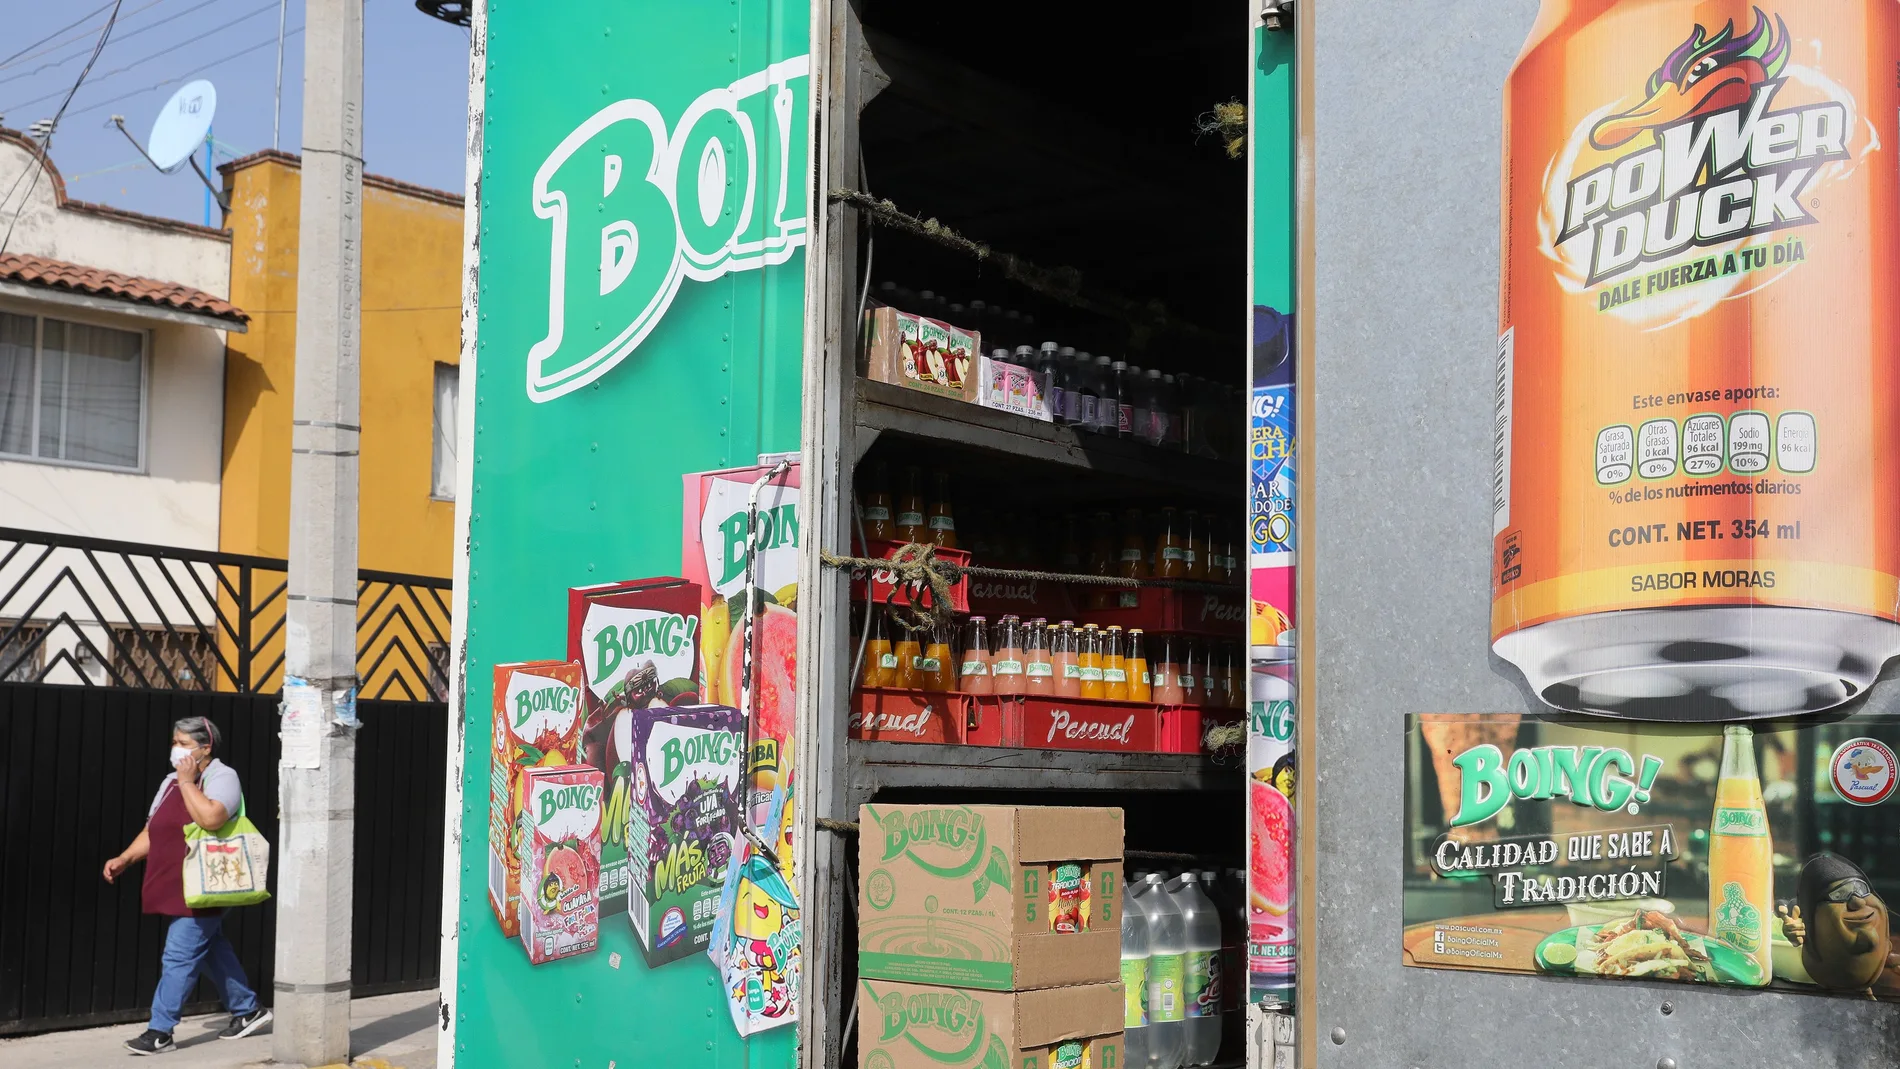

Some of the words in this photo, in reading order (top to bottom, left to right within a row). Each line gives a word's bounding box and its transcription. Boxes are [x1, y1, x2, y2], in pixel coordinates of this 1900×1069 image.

[526, 54, 809, 403] BOI
[1586, 166, 1814, 282] DUCK
[1600, 278, 1641, 311] DALE
[1647, 259, 1717, 296] FUERZA
[1723, 254, 1737, 275] A
[1742, 247, 1767, 271] TU
[1773, 238, 1805, 264] DÍA
[1632, 394, 1663, 410] Este
[1666, 390, 1721, 405] envase
[1724, 385, 1780, 404] aporta:
[1650, 424, 1668, 436] Otras
[1687, 419, 1720, 431] Azúcares
[1739, 427, 1760, 439] Sodio
[1605, 430, 1625, 442] Grasa
[1645, 435, 1670, 447] Grasas
[1690, 431, 1717, 442] Totales
[1600, 441, 1630, 454] Saturada
[1645, 449, 1650, 457] 0
[1652, 447, 1670, 457] kcal
[1687, 444, 1699, 453] 96
[1701, 442, 1719, 452] kcal
[1781, 444, 1792, 453] 96
[1794, 443, 1811, 453] kcal
[1602, 455, 1608, 463] 0
[1611, 453, 1627, 463] kcal
[1690, 460, 1716, 470] 27%
[1735, 458, 1759, 468] 10%
[1606, 469, 1623, 479] 0%
[1649, 464, 1667, 473] 0%
[1609, 491, 1623, 504] %
[1624, 487, 1641, 503] de
[1644, 486, 1663, 500] los
[1665, 480, 1753, 498] nutrimentos
[1755, 479, 1801, 495] diarios
[1251, 499, 1273, 514] DO
[1274, 498, 1292, 512] DE
[1608, 523, 1669, 548] CONT.
[1677, 520, 1724, 541] NET.
[1731, 519, 1770, 540] 354
[1777, 521, 1800, 540] ml
[967, 574, 1038, 605] ascual
[1631, 571, 1697, 592] SABOR
[1702, 570, 1776, 588] MORAS
[592, 614, 698, 686] BOING!
[998, 660, 1020, 671] BOING!
[1029, 662, 1051, 672] BOING!
[514, 686, 579, 729] BOING!
[850, 704, 932, 737] ascual
[1047, 709, 1135, 744] Pascual
[659, 731, 742, 788] BOING!
[750, 744, 774, 763] ABA
[1450, 744, 1664, 828] BOING!
[1849, 780, 1879, 791] Pascual
[538, 785, 603, 827] BOING!
[700, 793, 718, 814] UVA
[881, 810, 984, 862] BOING!
[1435, 840, 1559, 871] CALIDAD
[1568, 834, 1603, 861] QUE
[1608, 831, 1654, 858] SABE
[1659, 829, 1673, 855] A
[677, 863, 707, 893] FRUTA
[1498, 864, 1662, 904] TRADICIÓN
[1026, 903, 1037, 922] 5
[1102, 903, 1112, 921] 5
[694, 933, 709, 945] CONT.
[1261, 944, 1278, 956] NET.
[878, 991, 984, 1043] BOING!
